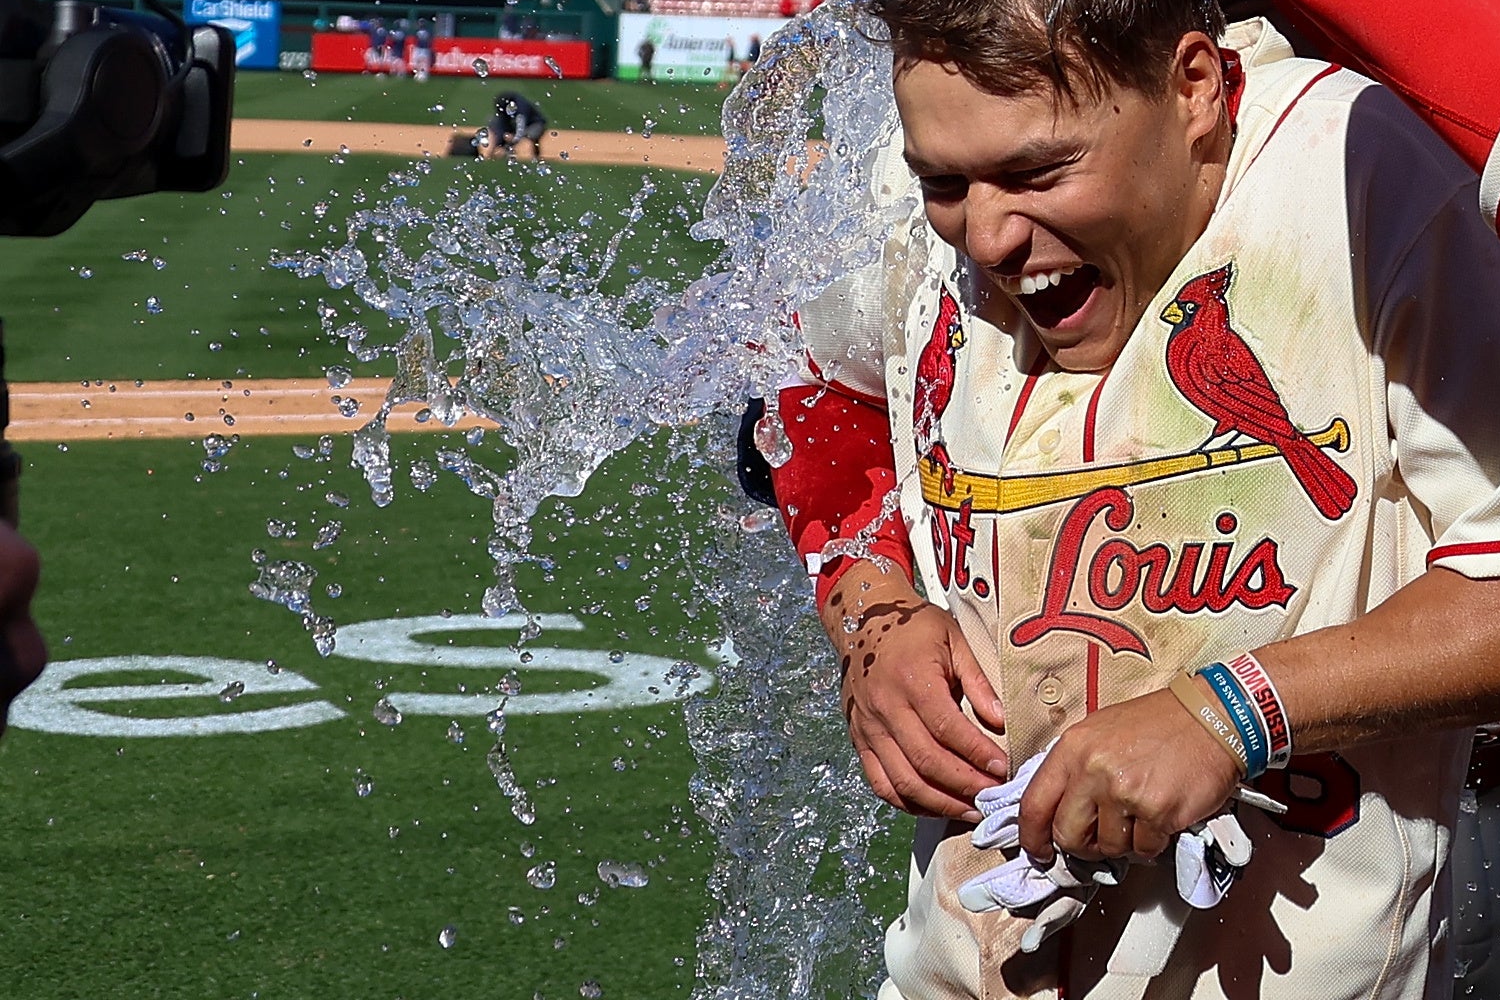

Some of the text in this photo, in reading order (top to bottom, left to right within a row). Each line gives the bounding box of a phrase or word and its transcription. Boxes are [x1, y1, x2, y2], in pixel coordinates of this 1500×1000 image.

[1009, 486, 1298, 662] Louis
[1200, 705, 1230, 736] 28:20
[1222, 685, 1260, 751] PHILIPPIANS
